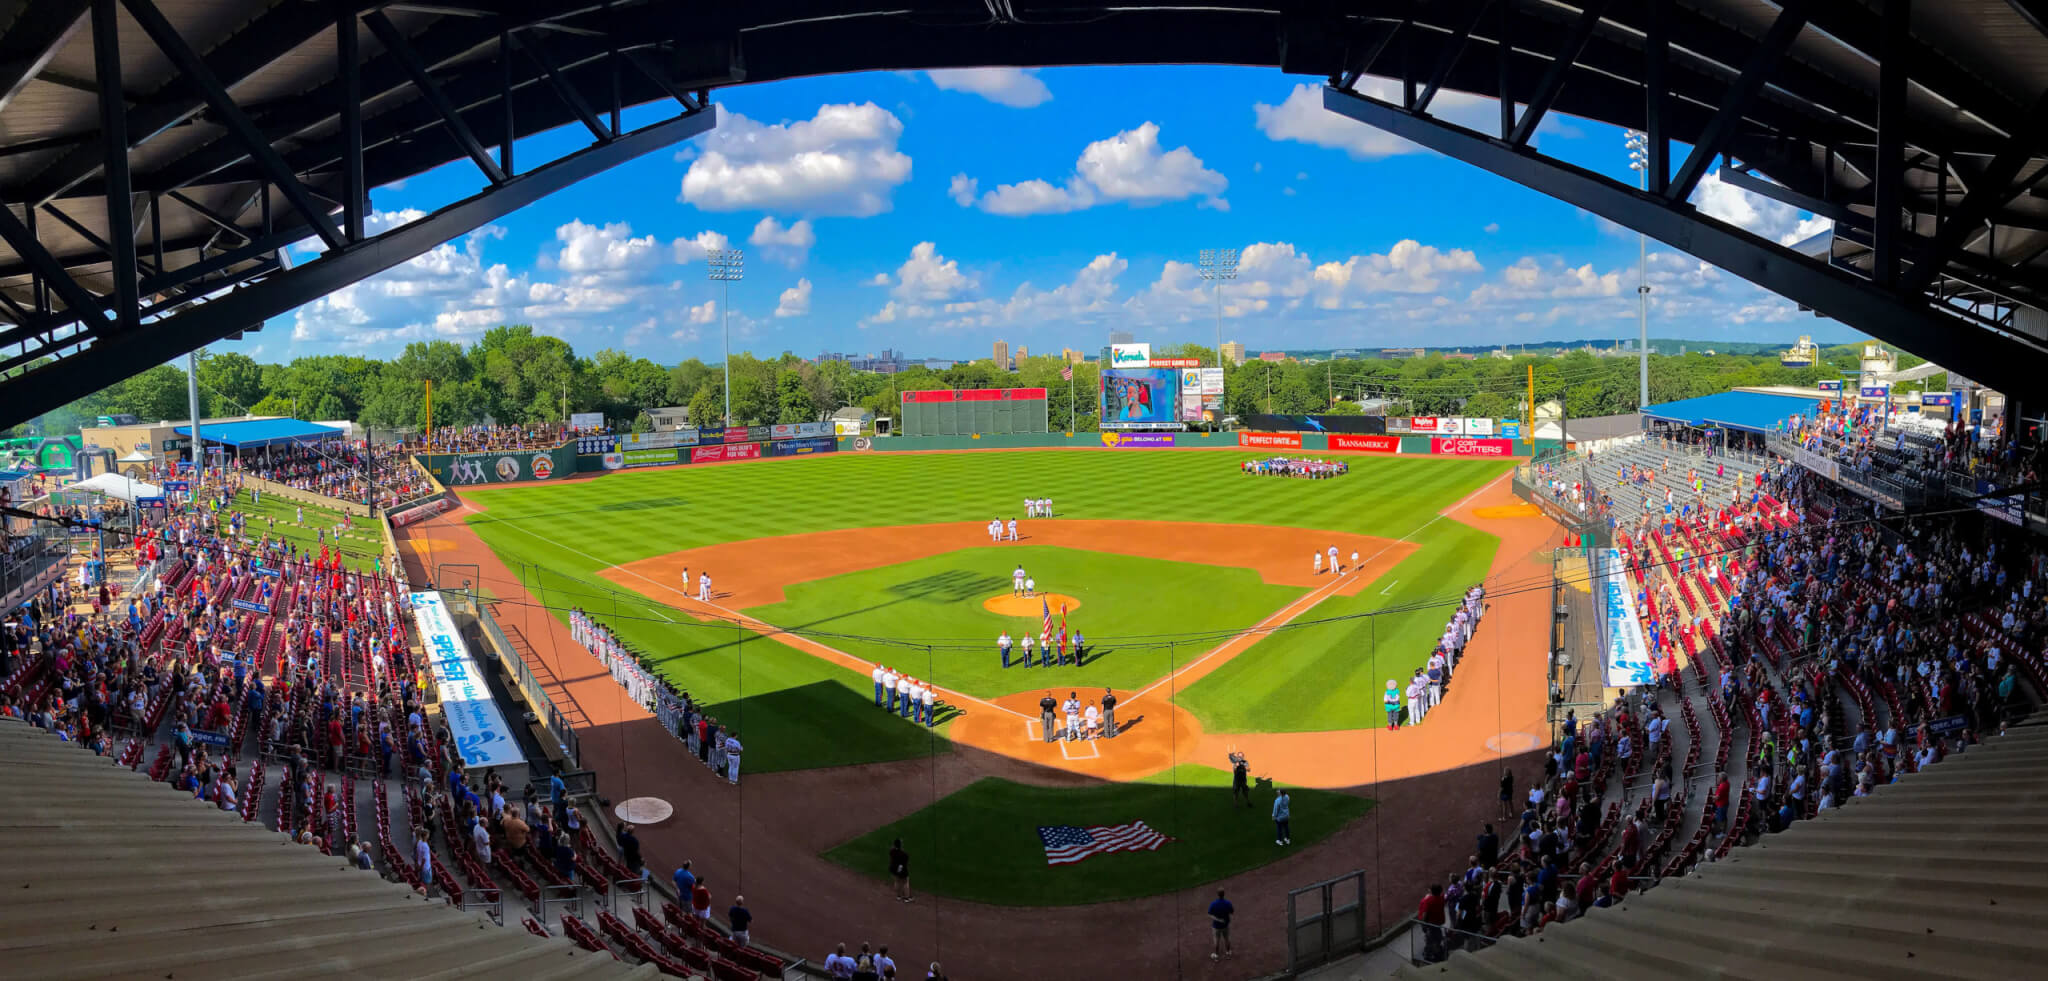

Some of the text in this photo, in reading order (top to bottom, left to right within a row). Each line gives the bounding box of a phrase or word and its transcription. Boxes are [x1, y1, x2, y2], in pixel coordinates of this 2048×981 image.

[1336, 438, 1390, 449] TRANSAMERICA
[1457, 446, 1502, 454] CUTTERS
[431, 634, 468, 682] SPLASH
